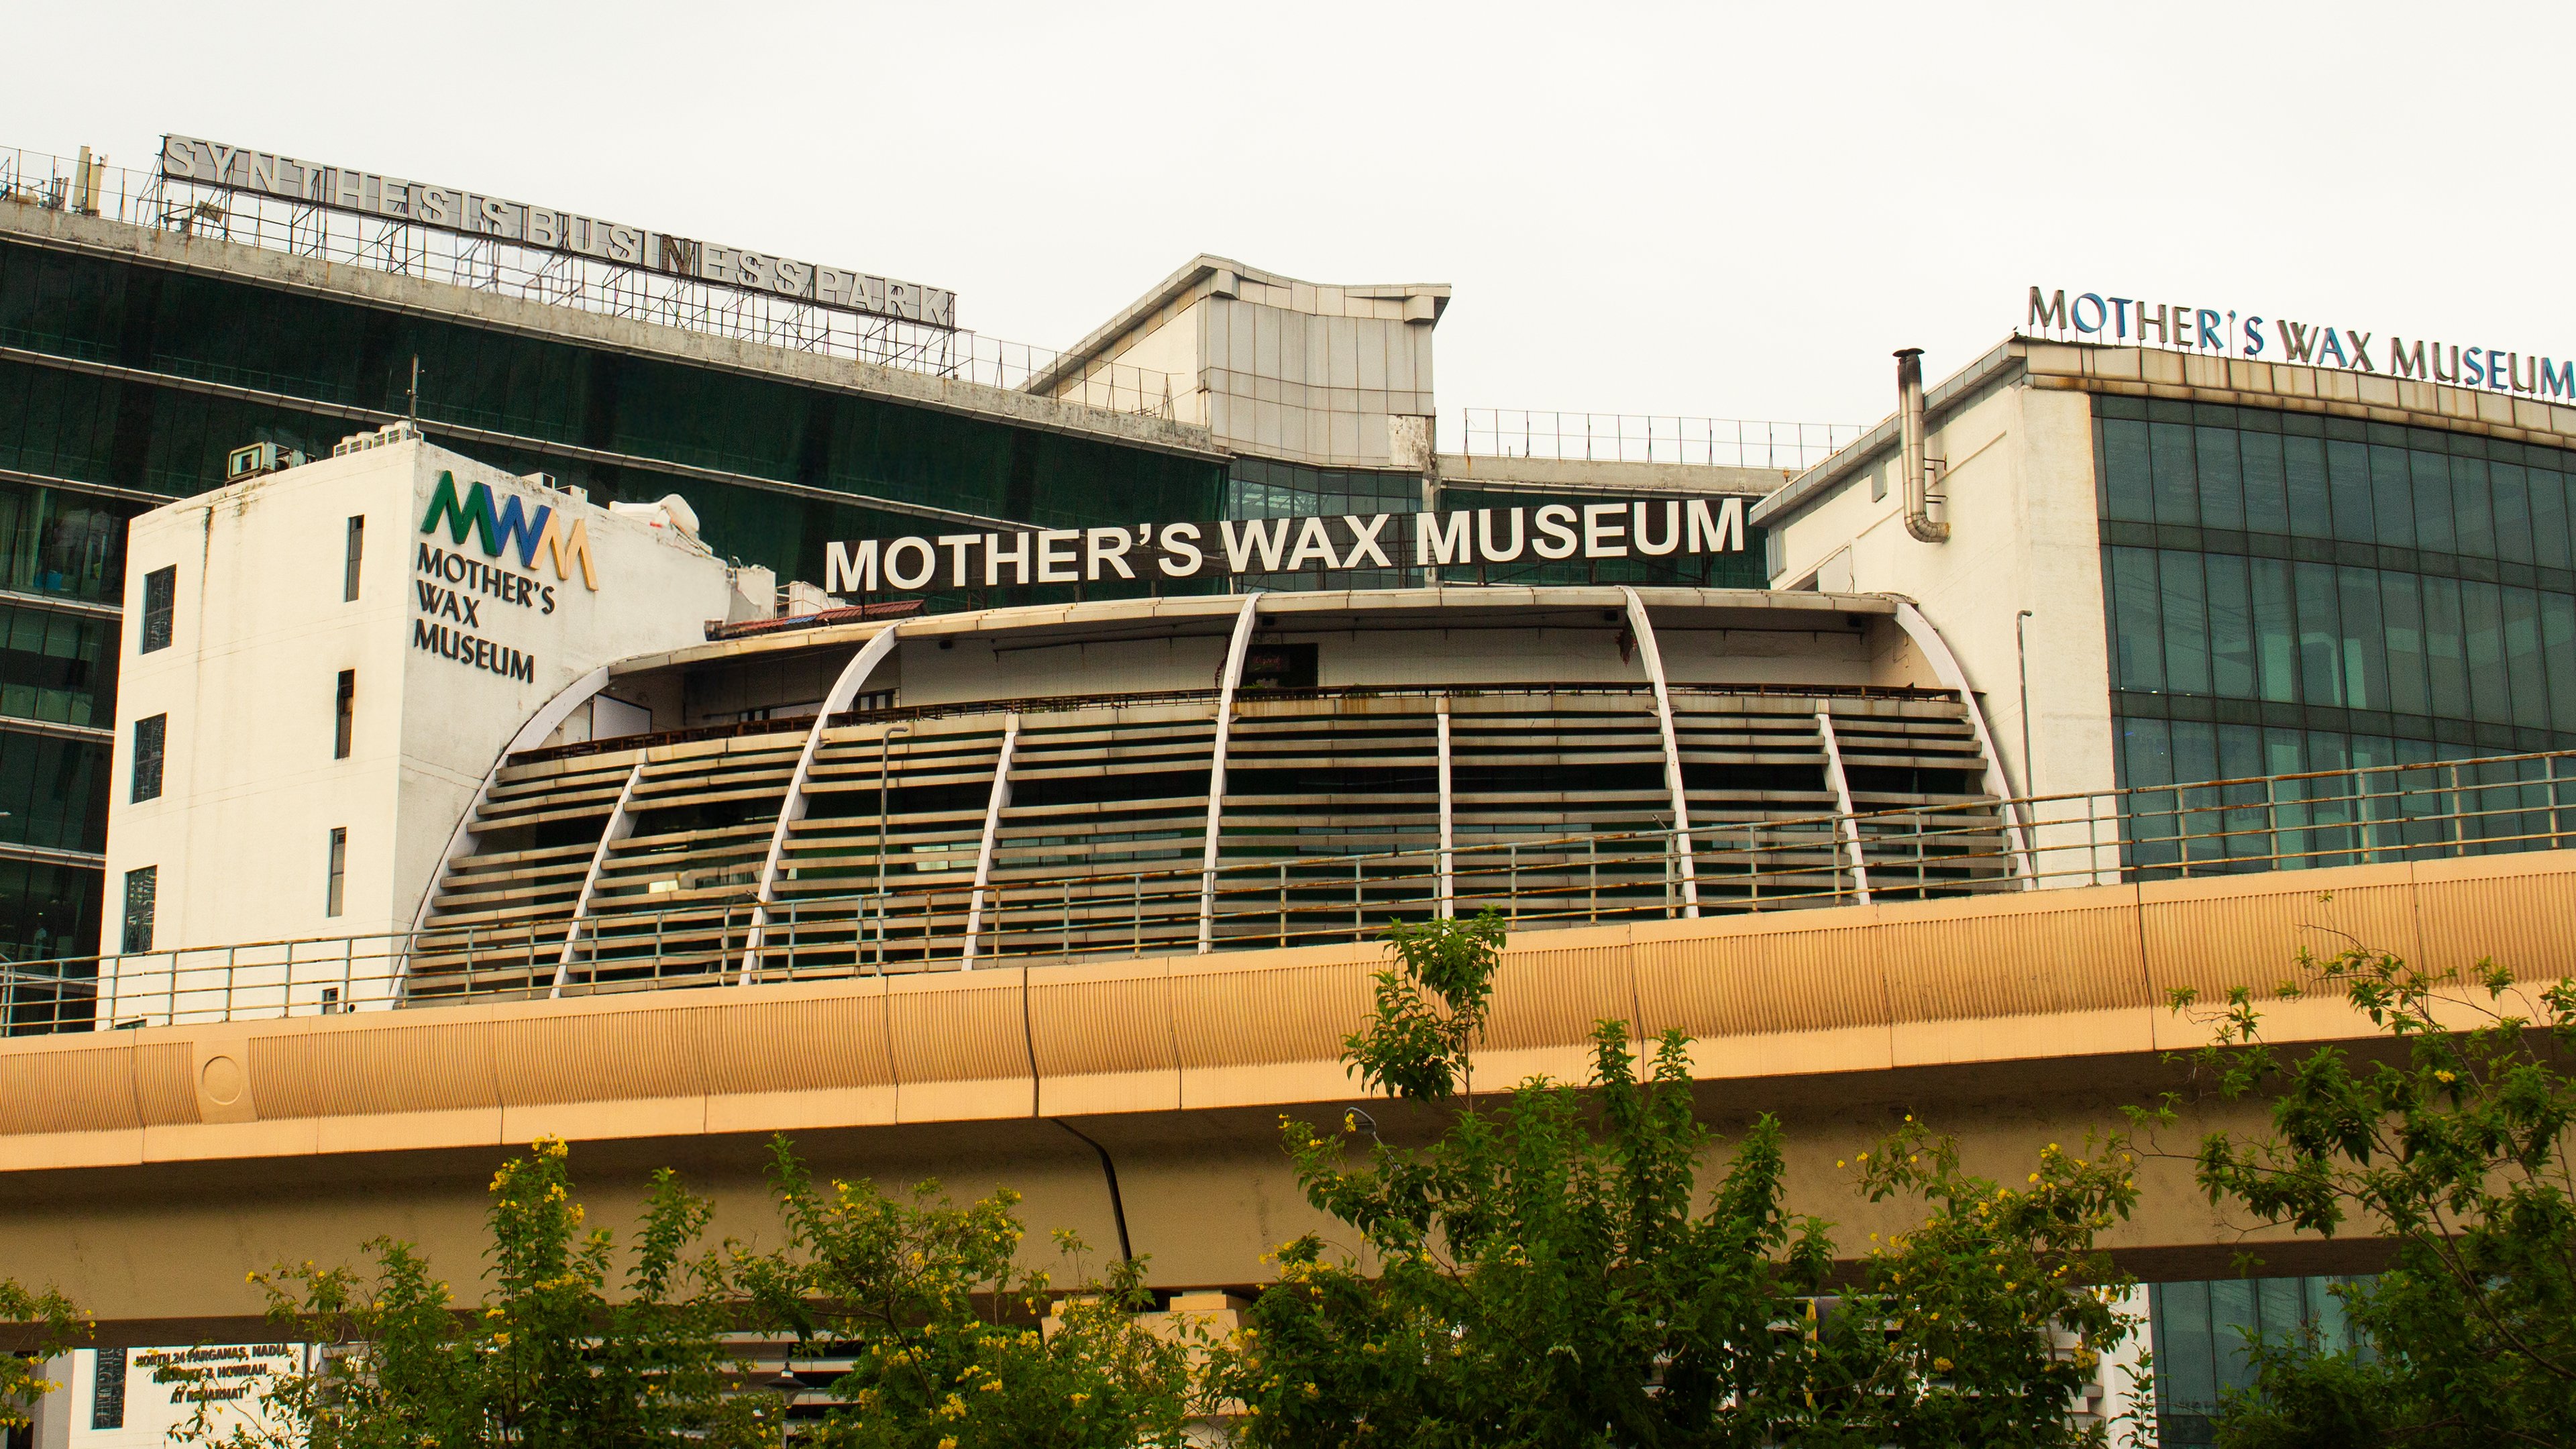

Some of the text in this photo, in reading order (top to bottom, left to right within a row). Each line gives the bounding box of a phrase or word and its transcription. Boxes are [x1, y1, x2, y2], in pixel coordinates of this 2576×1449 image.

[525, 204, 803, 299] BUSINESS
[815, 264, 955, 327] PARK
[2027, 286, 2575, 399] MOTHER'S WAX MUSEUM
[417, 542, 556, 615] MOTHER'S
[826, 498, 1743, 593] MOTHER'S WAX MUSEUM
[416, 579, 481, 629] WAX
[413, 618, 535, 684] MUSEUM
[136, 1353, 170, 1367] NORTH
[172, 1352, 186, 1363] 24
[252, 1344, 288, 1358] NADIA
[217, 1363, 267, 1378] HOWRAH
[170, 1387, 246, 1404] AT RJARHAT
